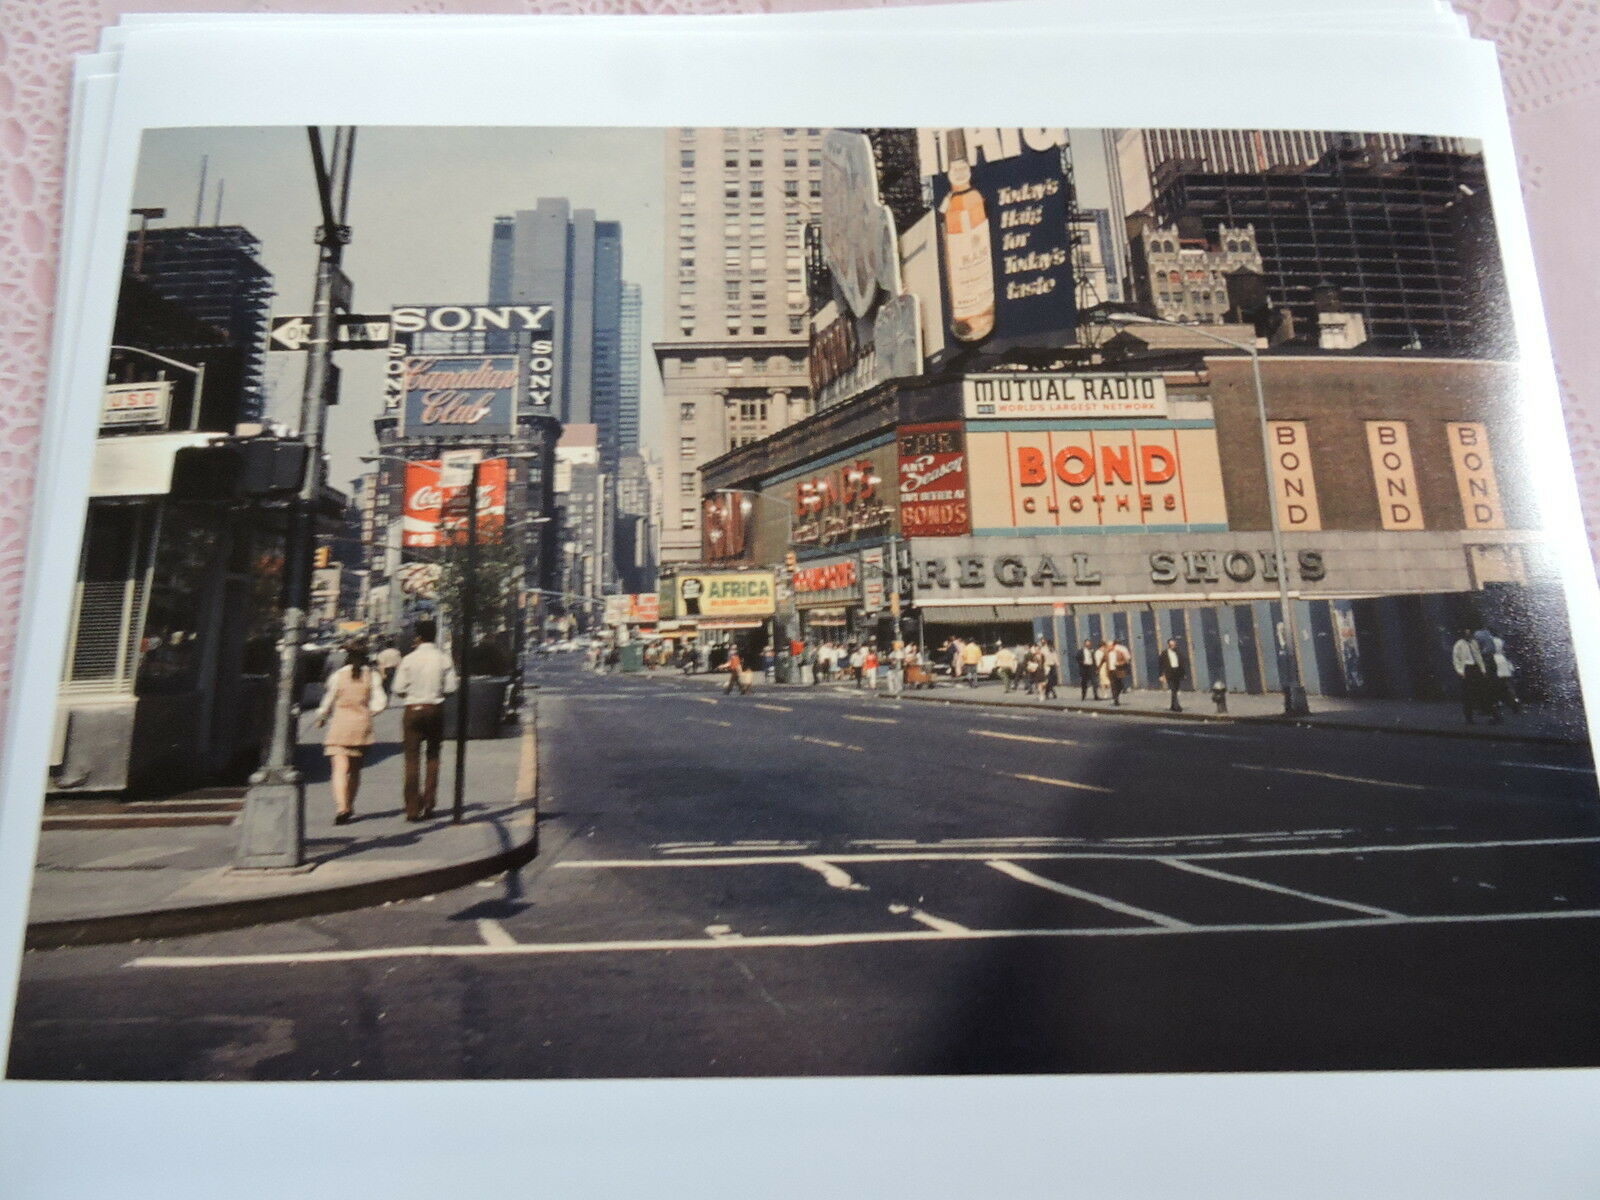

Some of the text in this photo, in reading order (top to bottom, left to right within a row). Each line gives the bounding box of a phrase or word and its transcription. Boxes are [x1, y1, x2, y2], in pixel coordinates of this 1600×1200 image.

[391, 306, 552, 332] SONY
[383, 343, 407, 408] SONY
[402, 358, 519, 392] Canadian
[529, 340, 552, 405] SONY
[975, 377, 1156, 401] MUTUAL RADIO
[420, 389, 496, 425] Club
[1049, 401, 1098, 411] LARGEST
[1102, 401, 1157, 411] NETWORK
[1017, 445, 1177, 487] BOND
[1276, 426, 1309, 525] BOND
[1377, 426, 1411, 524] BOND
[1458, 426, 1494, 524] BOND
[1023, 494, 1176, 514] CLOTHES
[916, 551, 1101, 590] REGAL
[1149, 549, 1328, 586] SHOES
